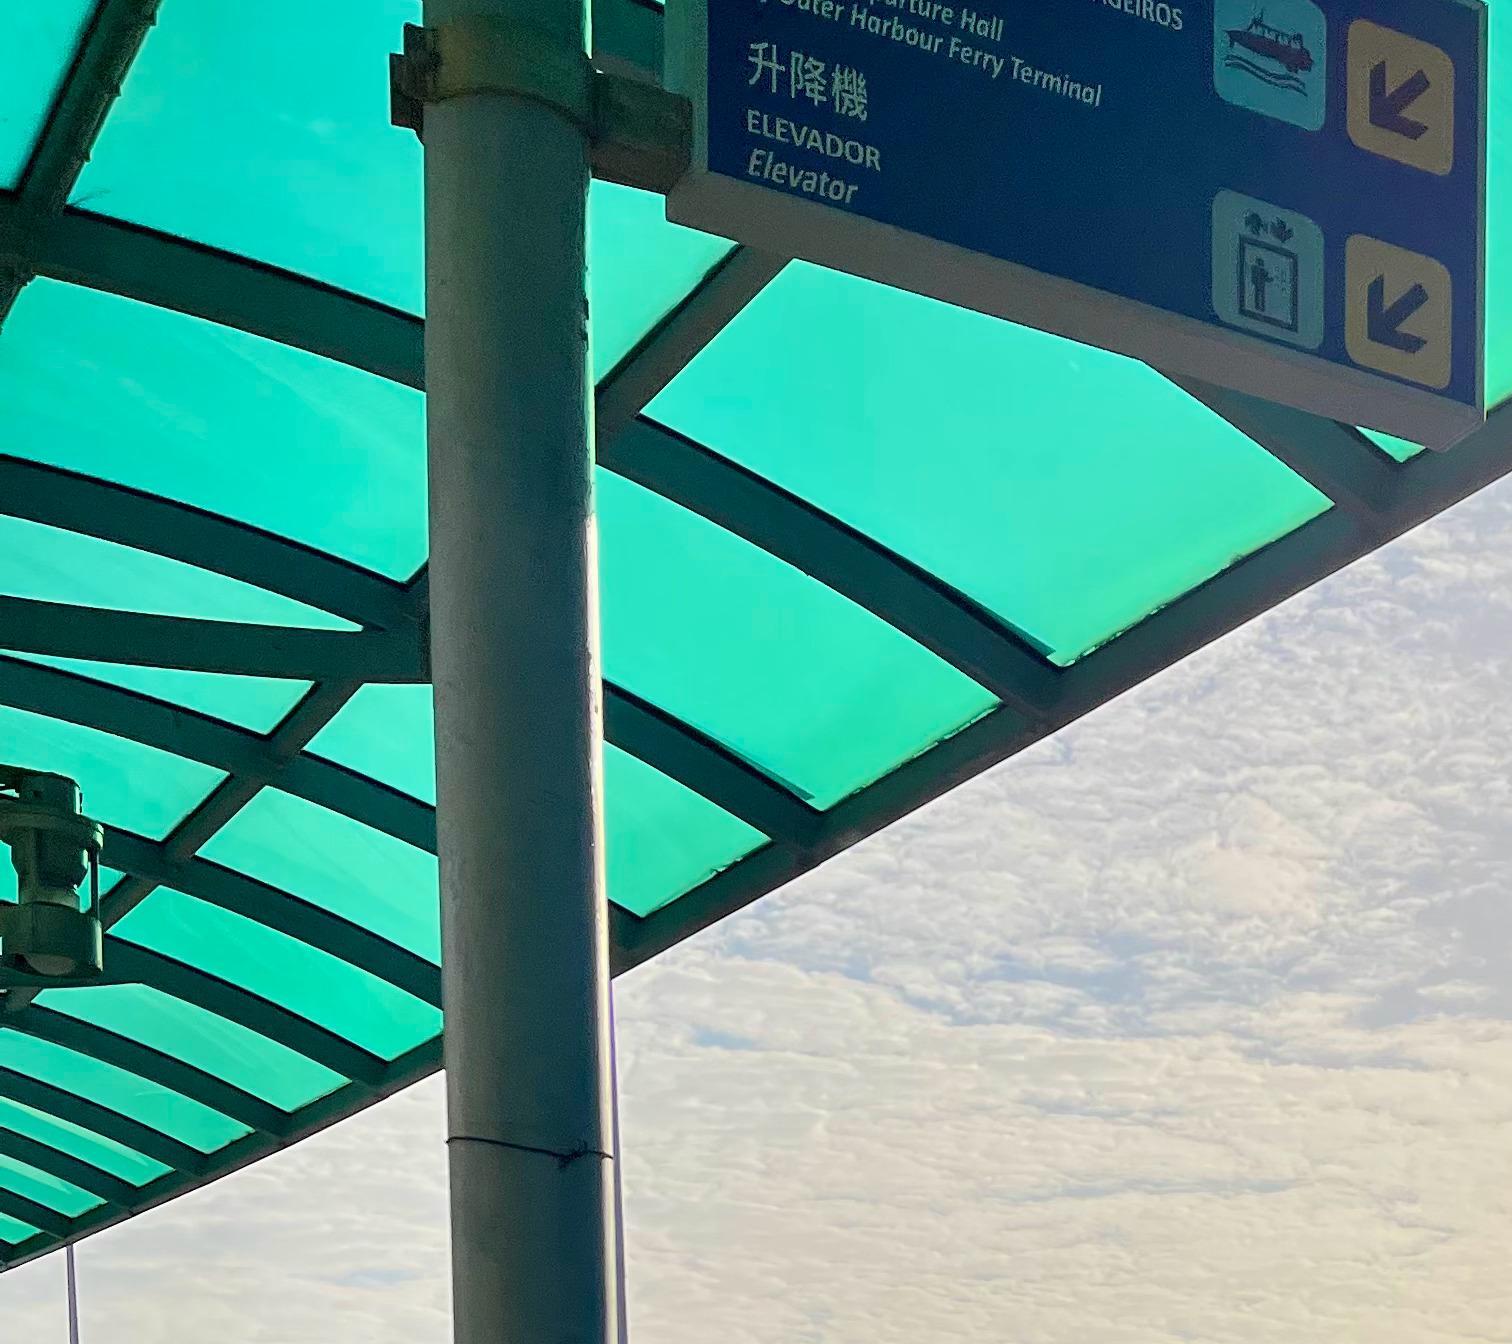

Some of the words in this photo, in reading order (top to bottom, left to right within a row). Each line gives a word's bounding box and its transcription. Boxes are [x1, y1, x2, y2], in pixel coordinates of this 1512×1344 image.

[868, 0, 954, 24] ture
[961, 8, 1004, 41] Hall
[1102, 0, 1182, 30] EIROS
[748, 42, 868, 121] 升降機
[780, 0, 844, 21] uter
[851, 4, 943, 53] Harbour
[949, 37, 1004, 79] Ferry
[1011, 55, 1102, 107] Terminal
[747, 109, 881, 172] ELEVADOR
[748, 148, 859, 204] Elevator
